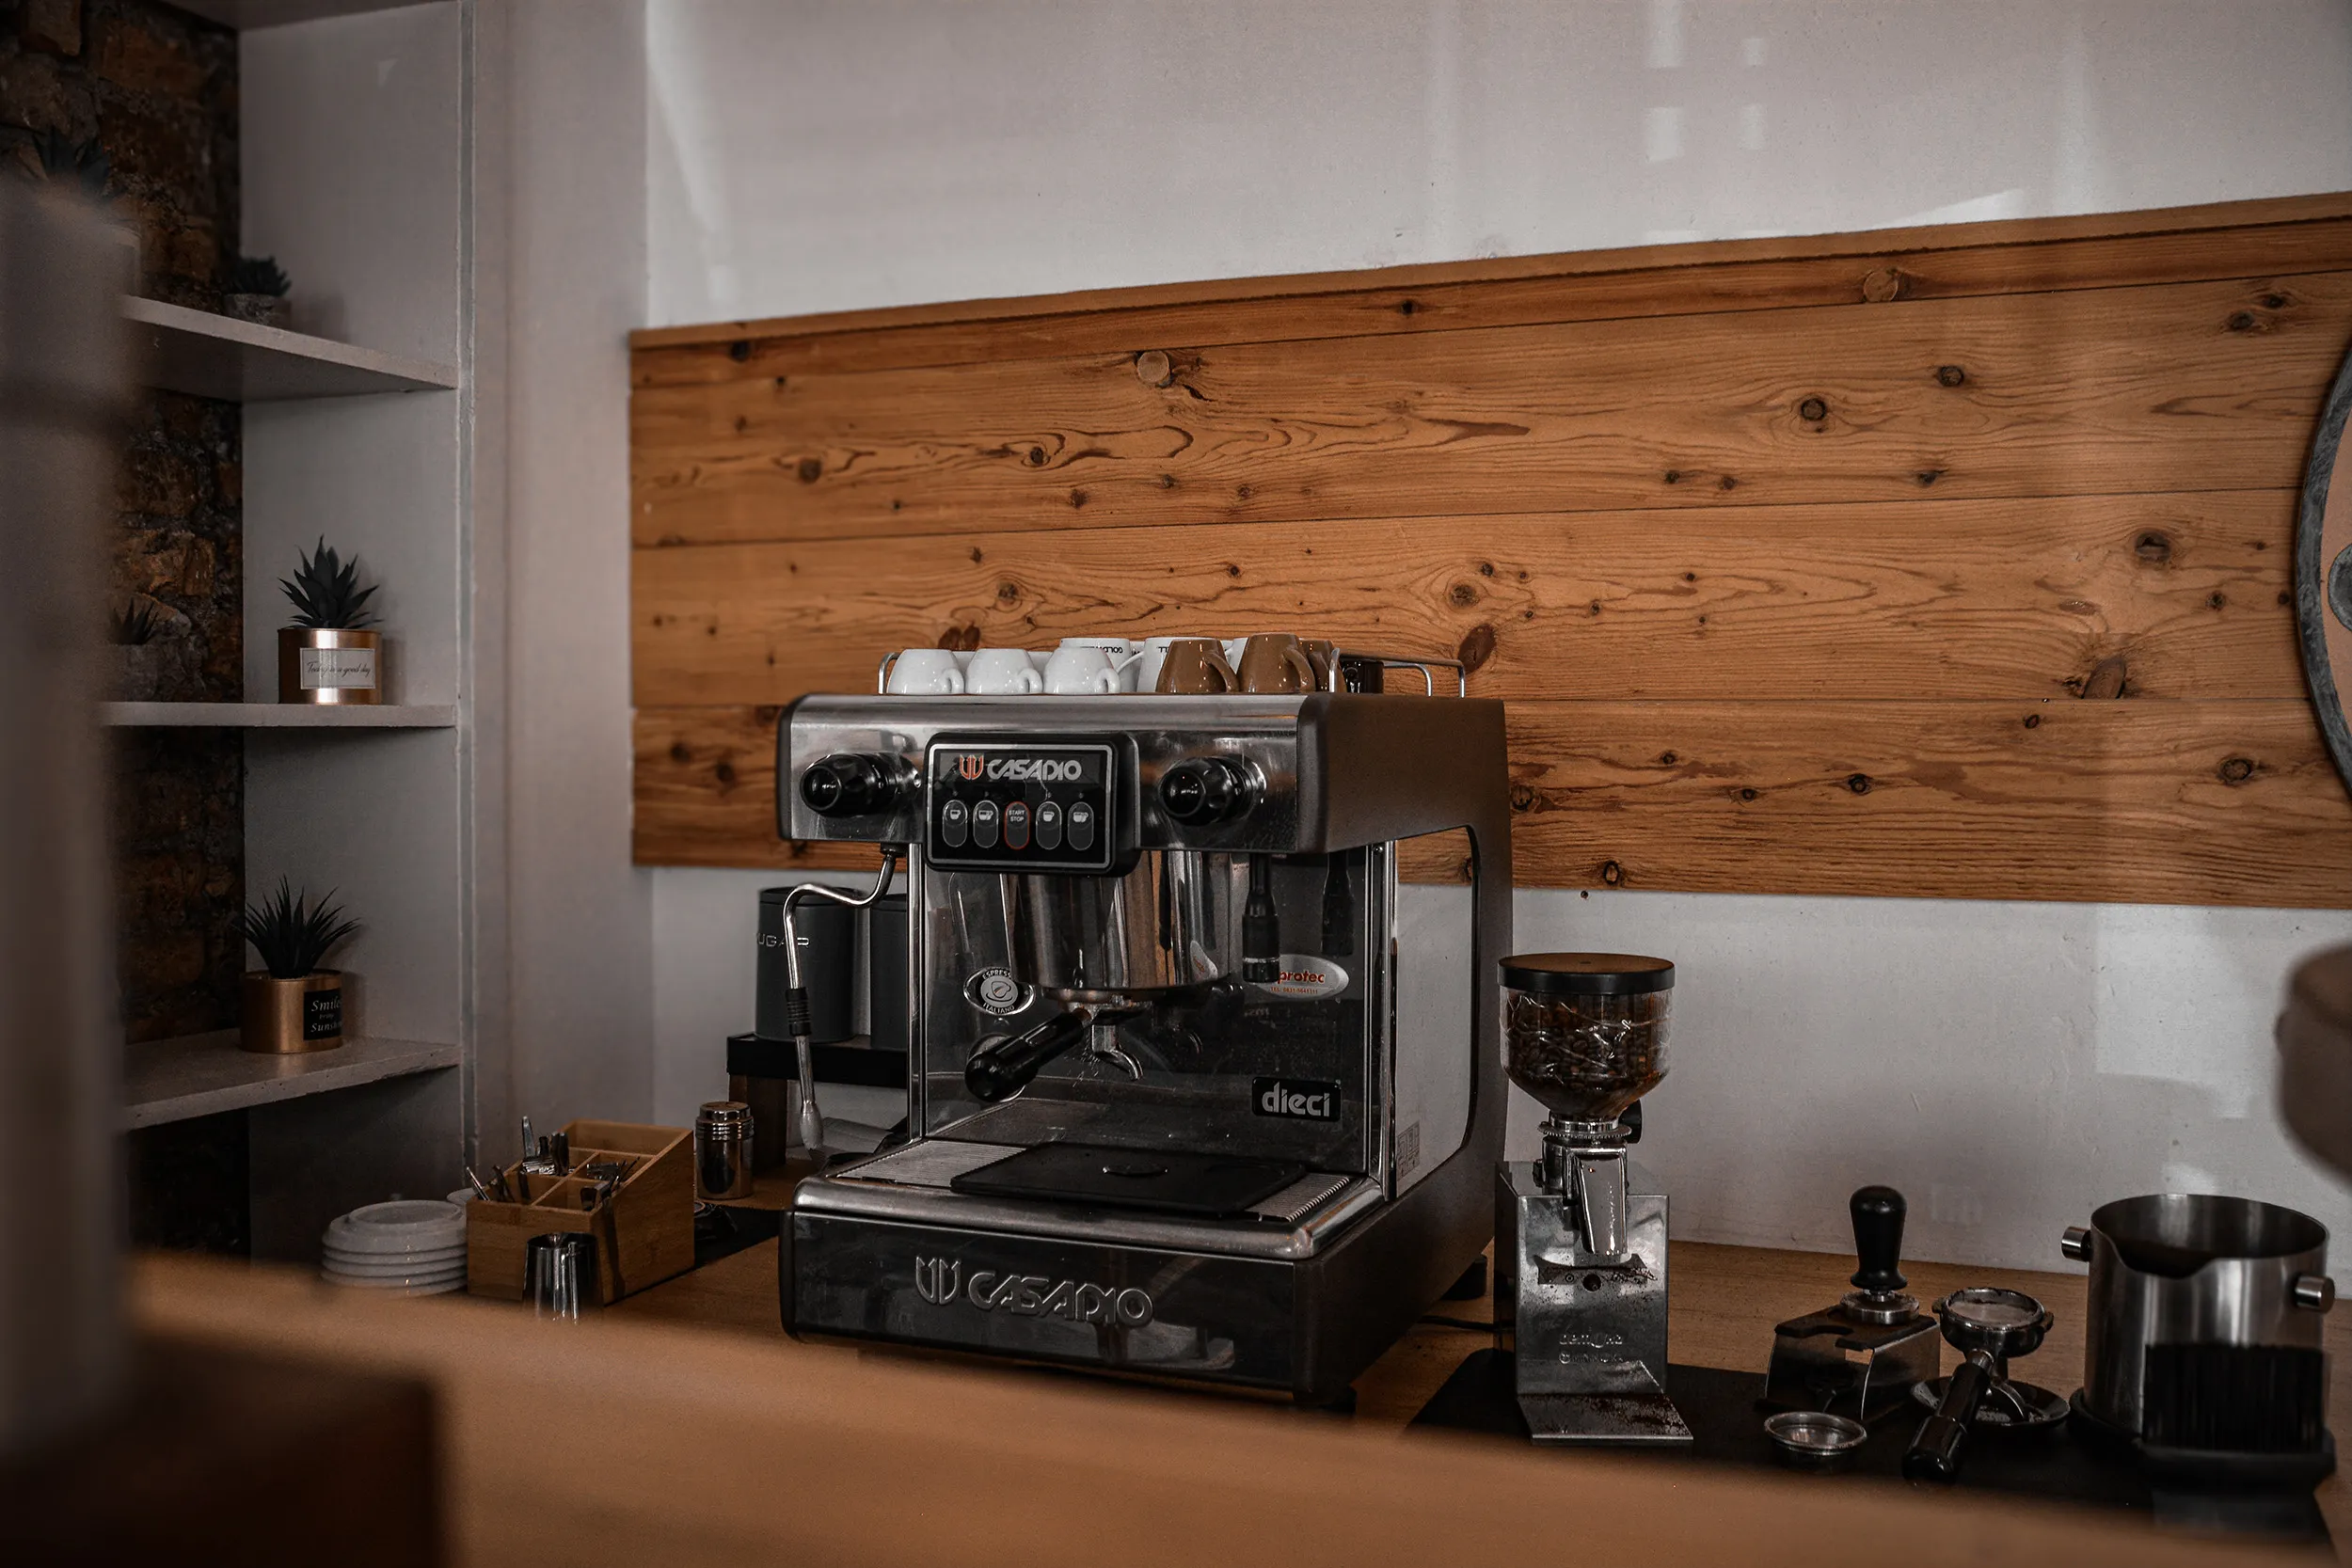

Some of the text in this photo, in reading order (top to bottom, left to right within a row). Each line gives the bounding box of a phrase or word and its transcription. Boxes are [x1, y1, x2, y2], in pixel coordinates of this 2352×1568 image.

[987, 759, 1082, 781] CASADIO
[982, 1002, 1015, 1014] ITALIANO
[1262, 1081, 1330, 1117] dieci
[967, 1271, 1153, 1327] CASADIO
